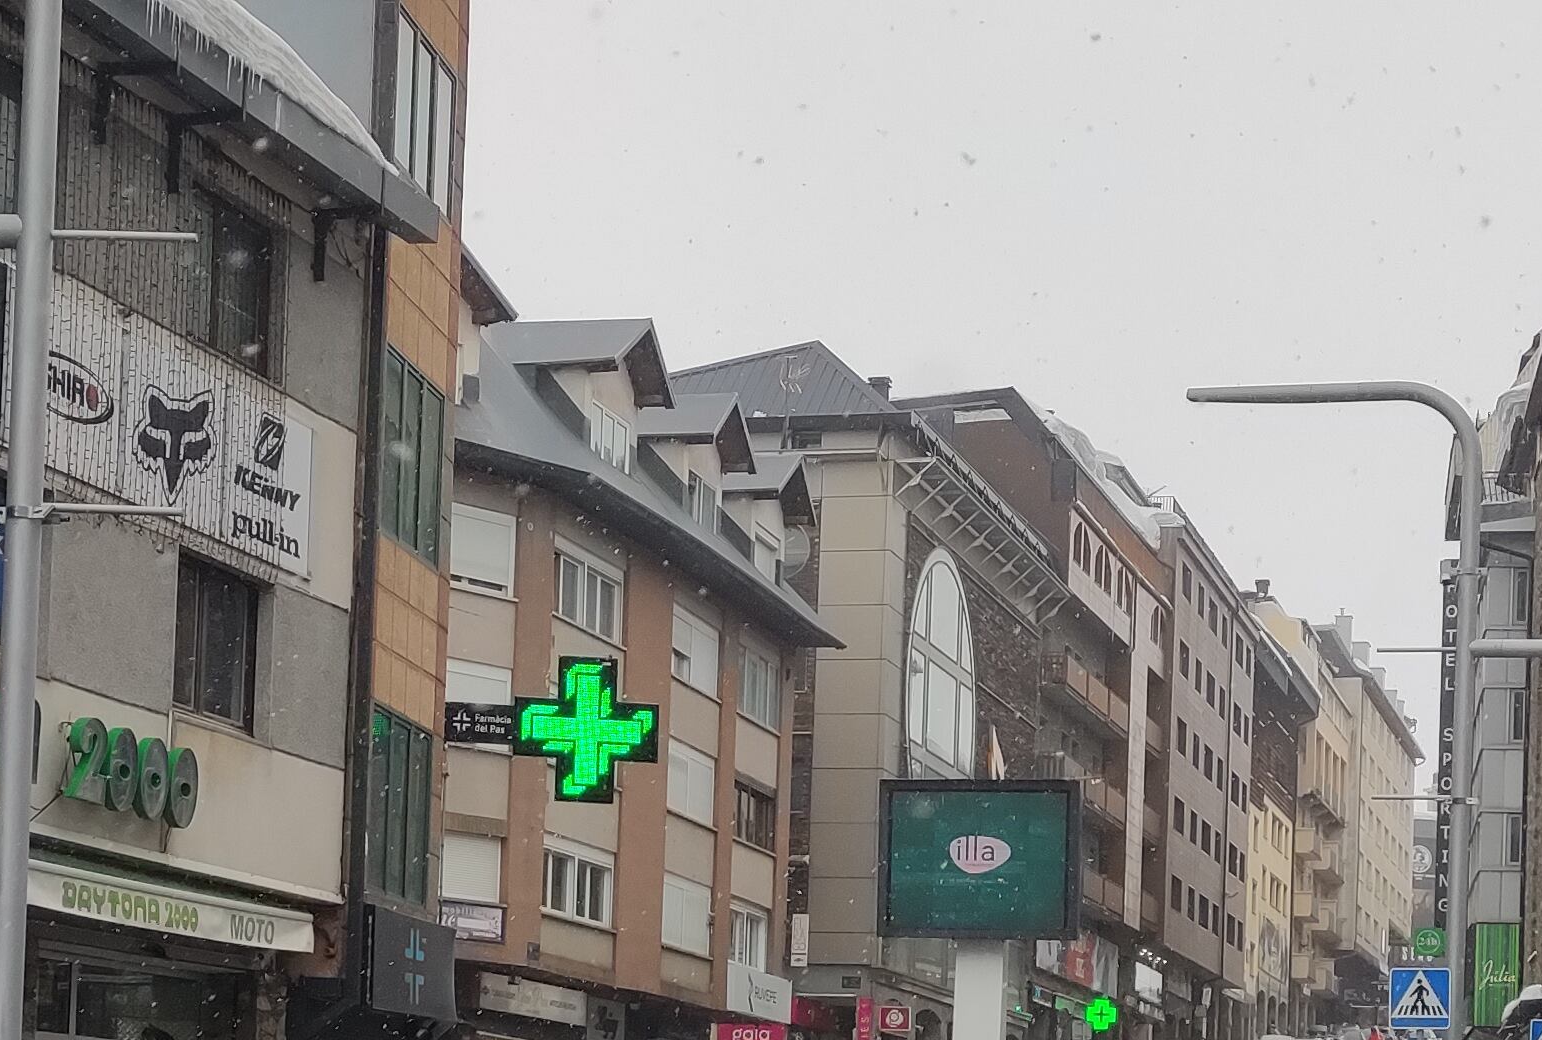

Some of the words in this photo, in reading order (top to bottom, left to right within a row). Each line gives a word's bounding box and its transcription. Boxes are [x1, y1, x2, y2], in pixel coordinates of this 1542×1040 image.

[231, 511, 301, 559] pull-in
[475, 723, 488, 732] del
[490, 725, 506, 734] Pas
[65, 717, 199, 829] 2000
[957, 834, 995, 862] illa
[61, 880, 161, 926] DAYTONA
[164, 901, 199, 934] 2000
[229, 913, 276, 945] MOTO
